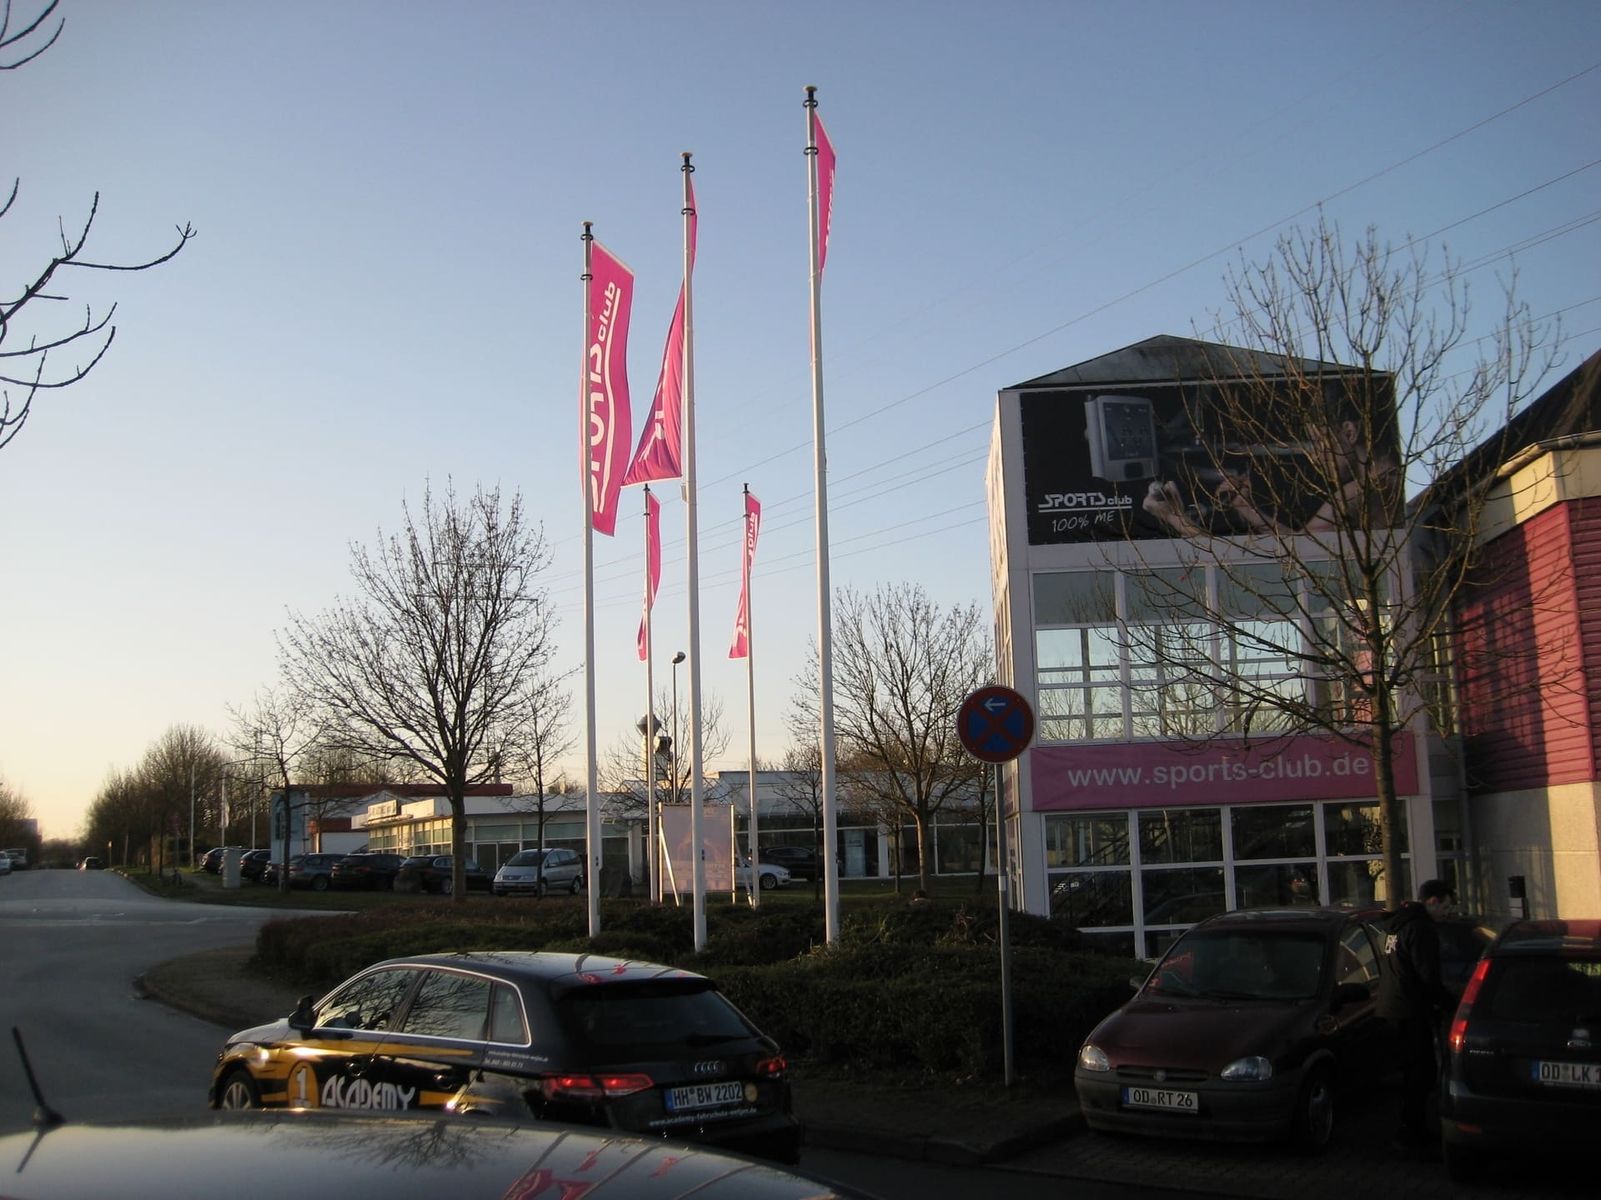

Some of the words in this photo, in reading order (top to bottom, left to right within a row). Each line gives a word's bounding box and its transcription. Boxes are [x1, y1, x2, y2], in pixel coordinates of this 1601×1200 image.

[597, 281, 616, 342] club
[1038, 492, 1107, 508] SPORTS
[1107, 495, 1133, 505] club
[1051, 514, 1090, 533] 100%
[1094, 510, 1116, 525] ME
[1066, 752, 1370, 790] www.sports-club.de
[1541, 1063, 1561, 1080] OD
[1571, 1065, 1591, 1083] LK
[321, 1074, 416, 1111] ACADEMY
[673, 1088, 689, 1106] HH
[715, 1083, 742, 1101] 2202
[1133, 1089, 1150, 1104] OD
[1157, 1091, 1174, 1106] RT
[1176, 1093, 1194, 1108] 26
